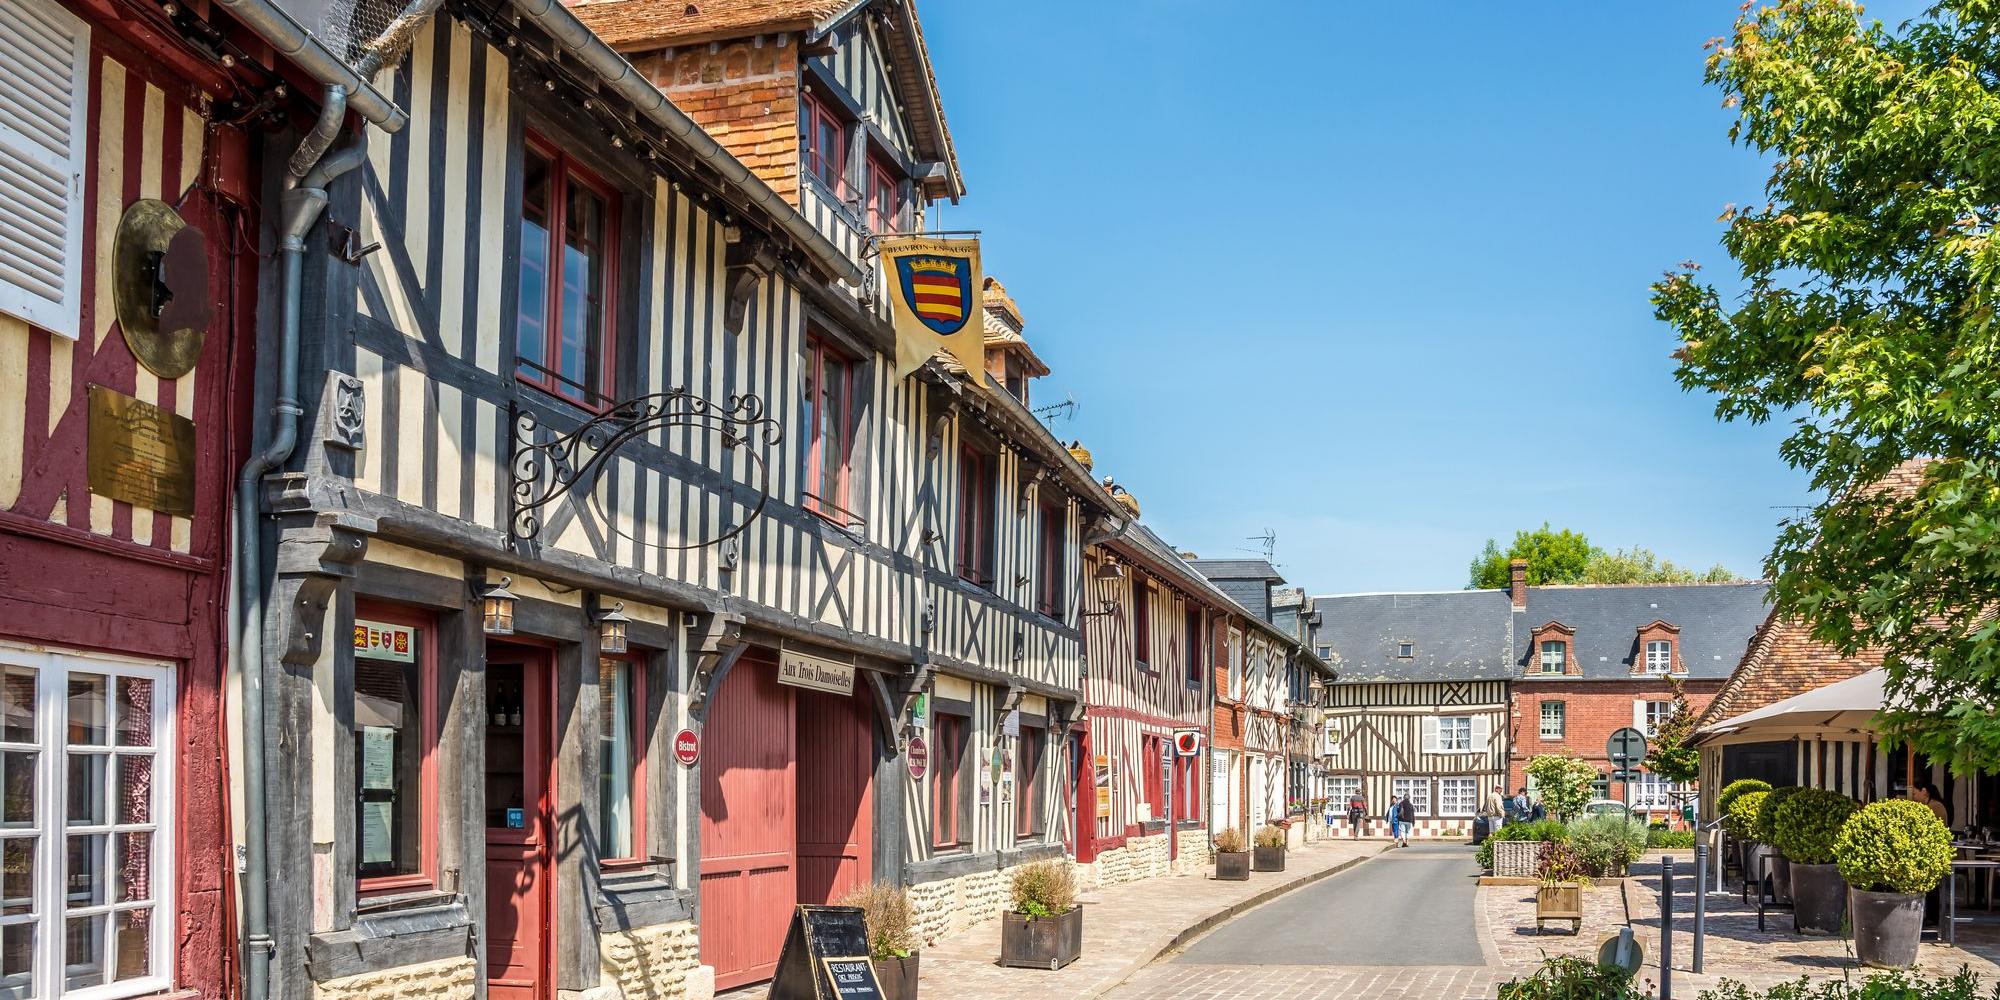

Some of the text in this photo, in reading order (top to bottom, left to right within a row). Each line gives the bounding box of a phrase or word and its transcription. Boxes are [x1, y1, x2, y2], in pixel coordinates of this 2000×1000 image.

[782, 659, 851, 688] Aux Trois Damoiselles
[678, 740, 697, 752] Bistrot
